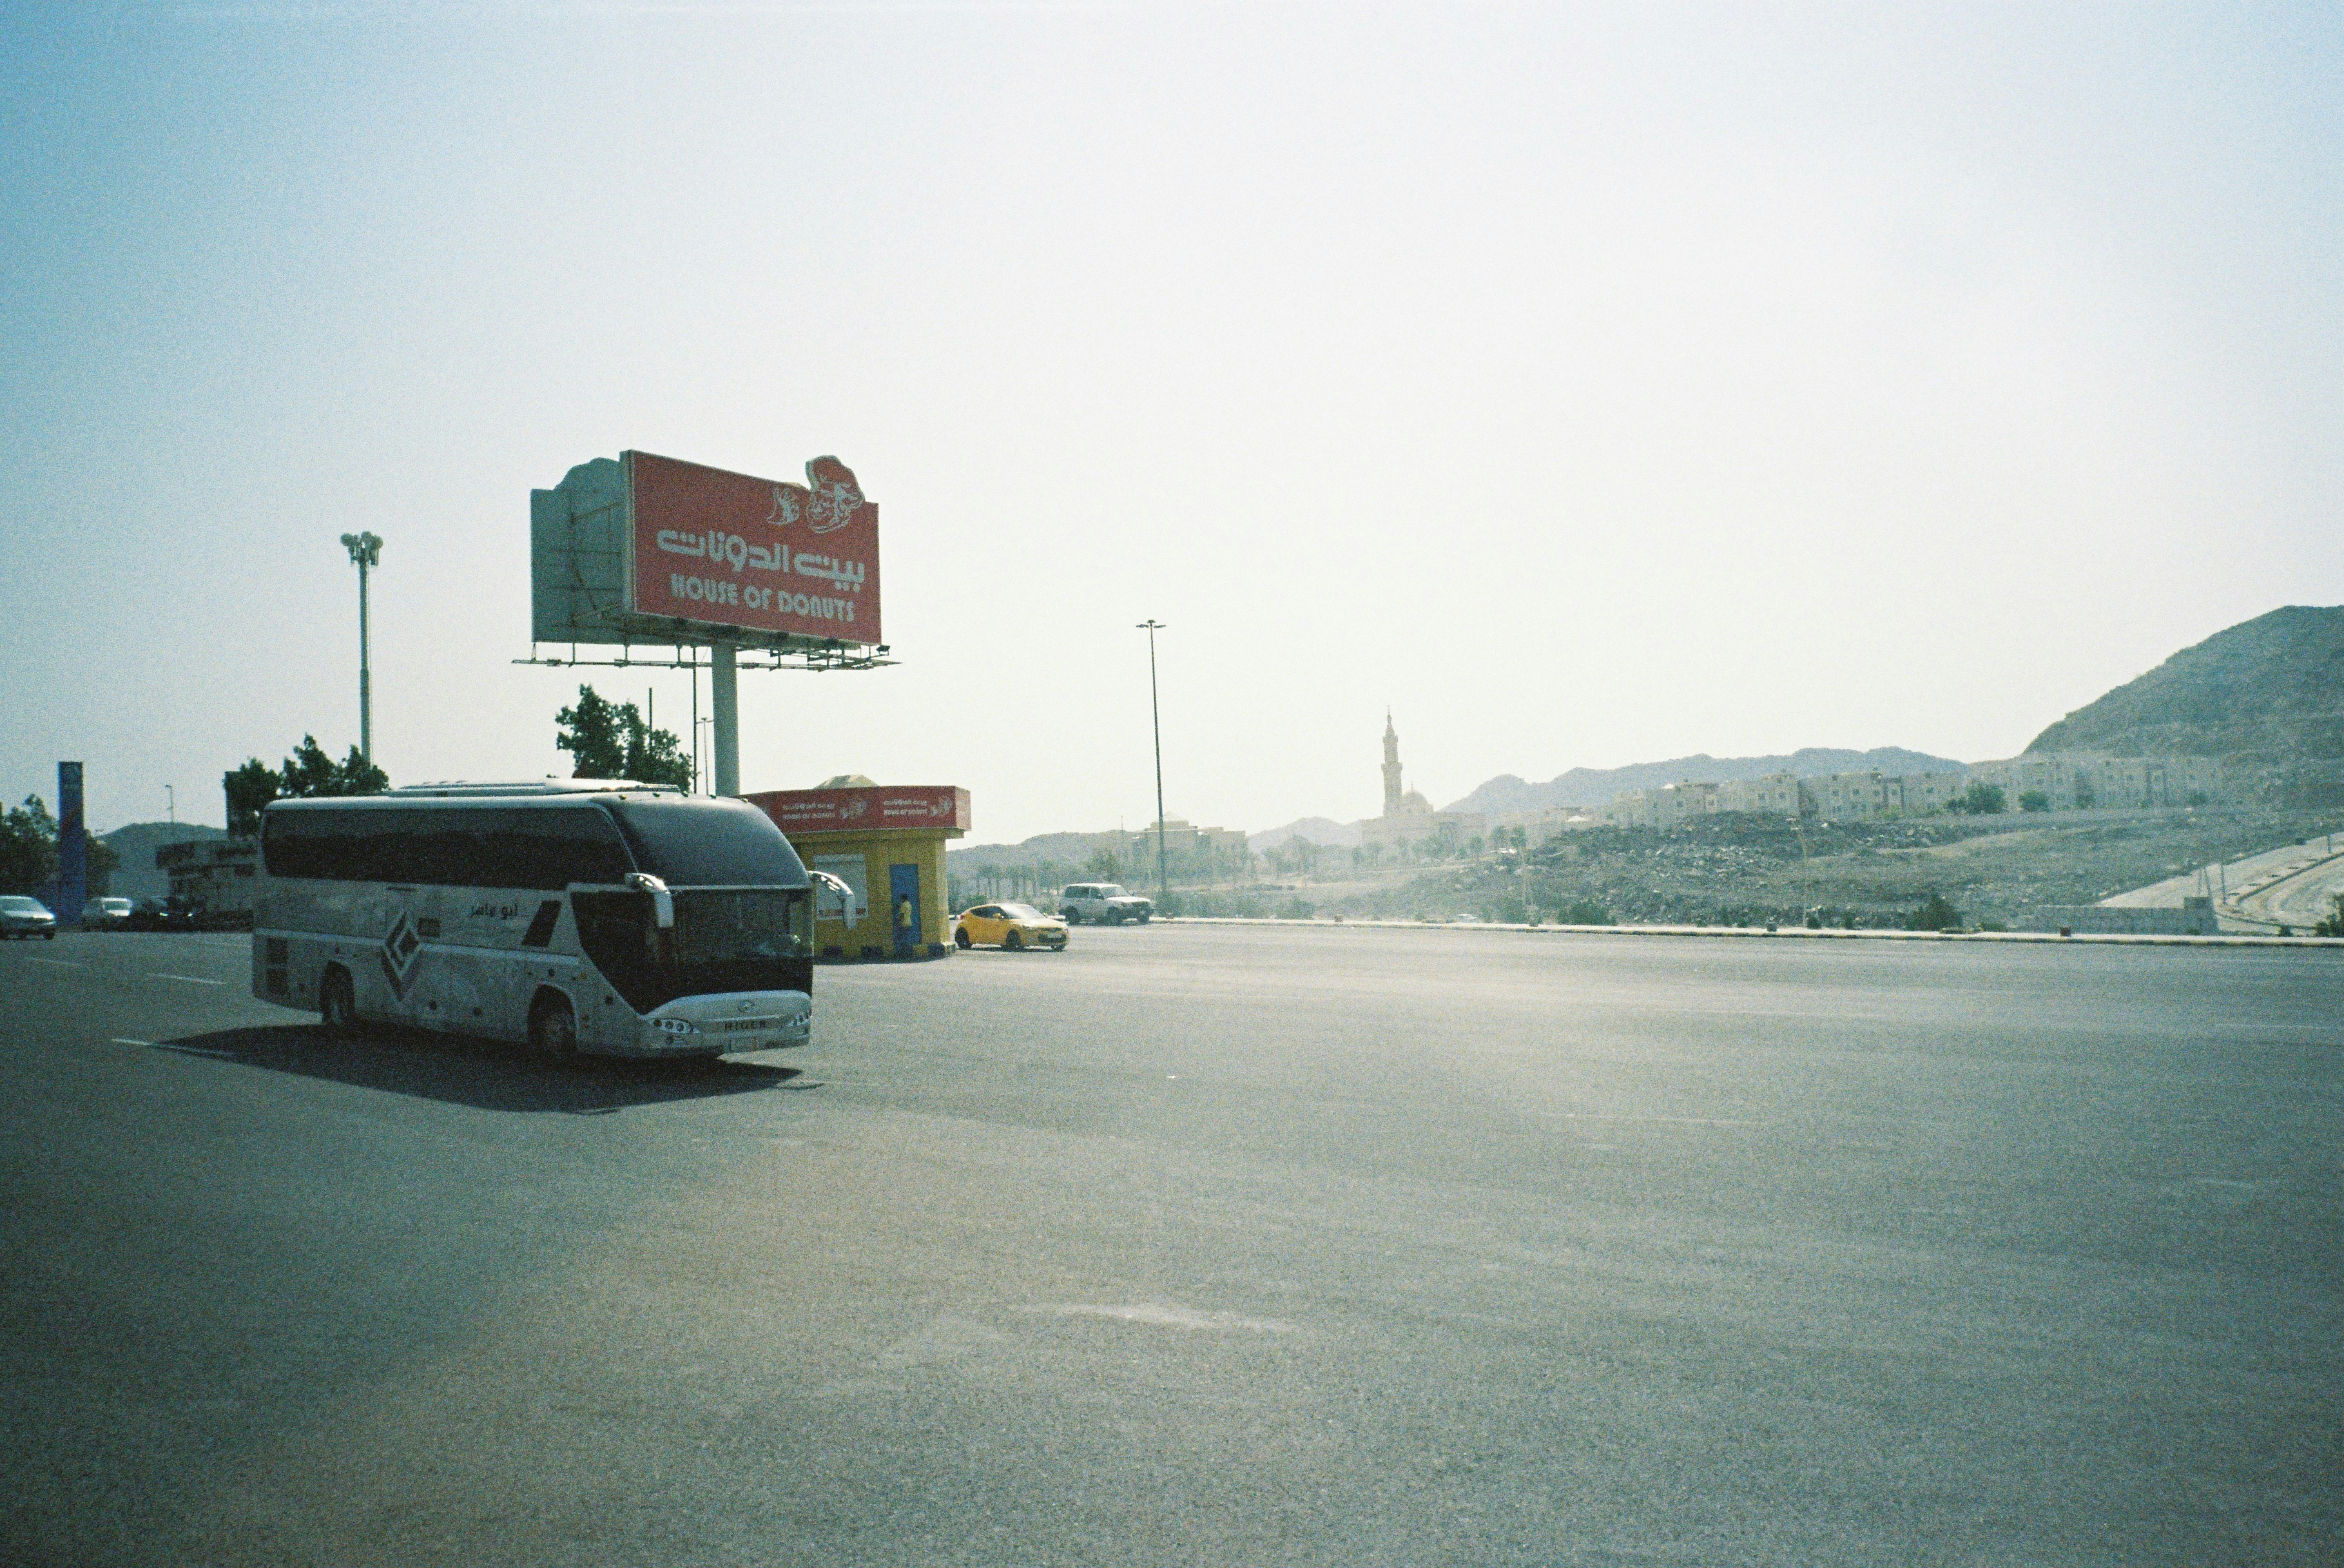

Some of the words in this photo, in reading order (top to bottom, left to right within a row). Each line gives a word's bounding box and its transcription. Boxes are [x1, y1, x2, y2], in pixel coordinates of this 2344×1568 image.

[656, 528, 790, 573] الدونات
[793, 551, 865, 593] بيت
[670, 574, 739, 606] HOUSE
[744, 586, 773, 611] OF
[778, 590, 855, 623] DONUTS
